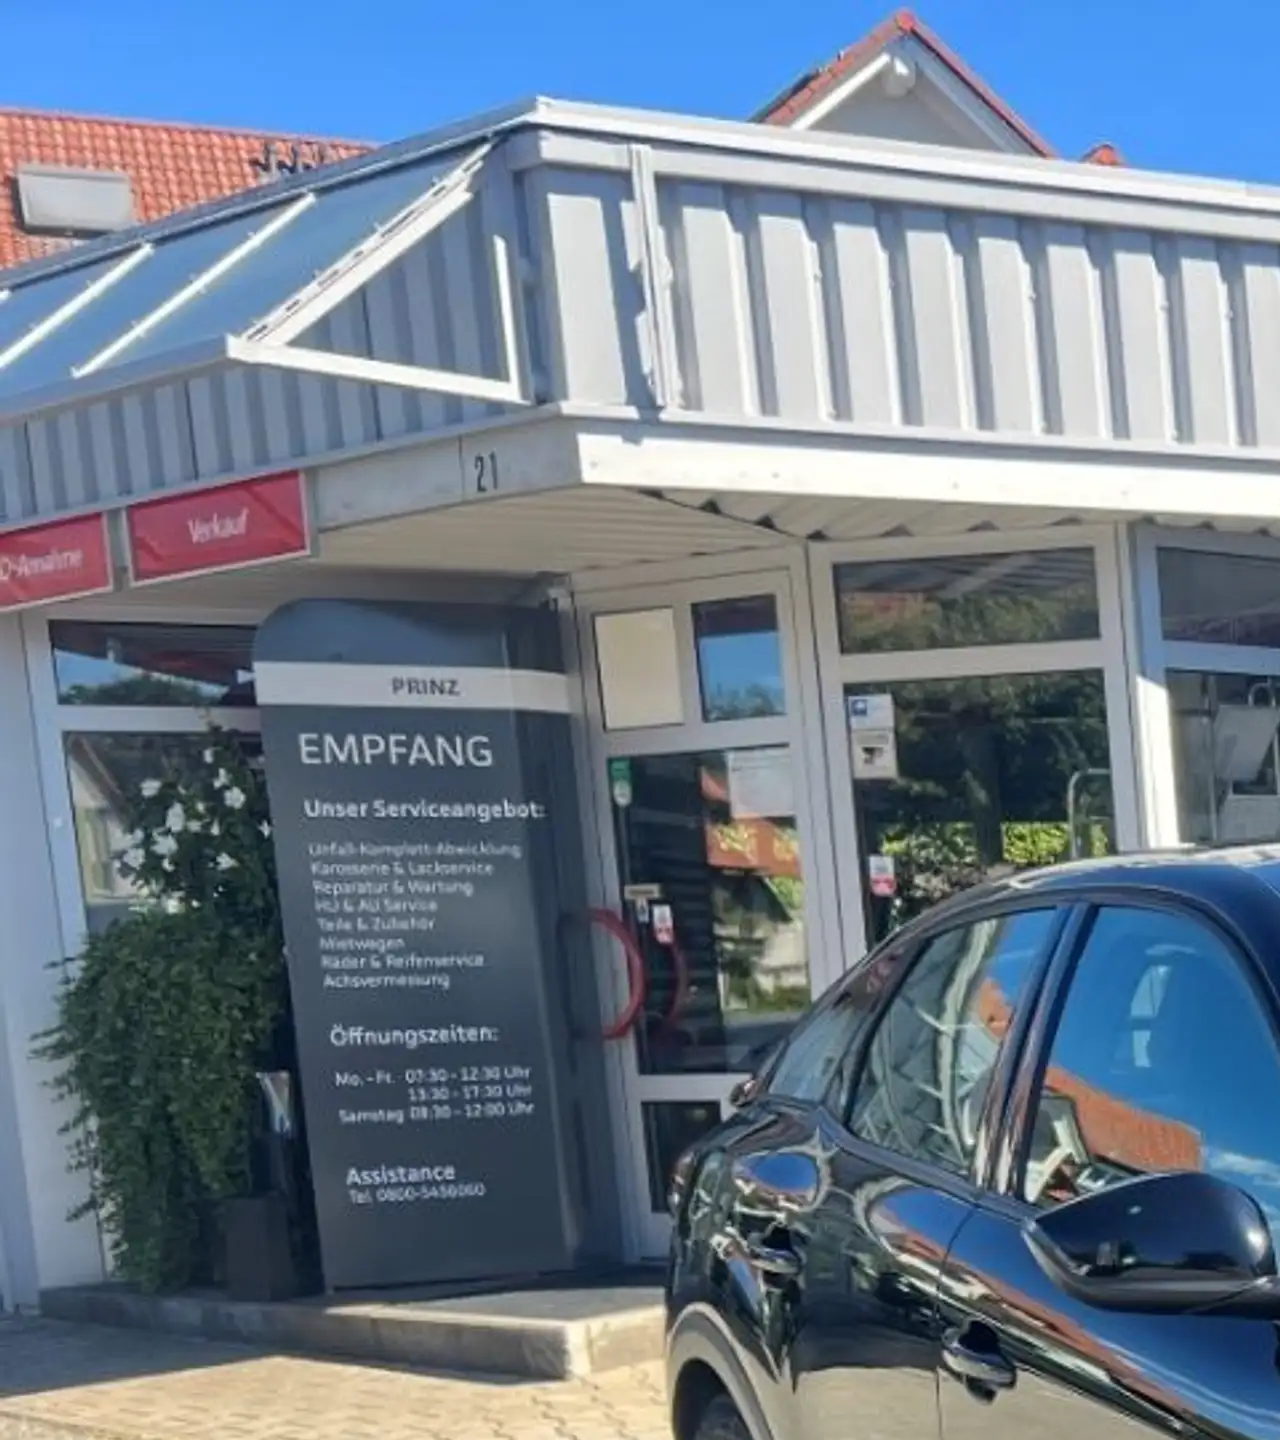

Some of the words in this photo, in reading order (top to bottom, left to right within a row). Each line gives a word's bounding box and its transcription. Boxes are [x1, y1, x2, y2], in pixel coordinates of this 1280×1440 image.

[475, 453, 498, 492] 21
[187, 507, 249, 543] Verkauf
[391, 676, 460, 696] PRINZ
[298, 733, 493, 768] EMPFANG
[304, 801, 367, 818] Unser
[373, 799, 546, 823] Serviceangebot:
[312, 880, 388, 896] Reparatur
[408, 880, 474, 897] Wartung
[384, 899, 438, 913] Service
[319, 936, 405, 953] Mietwagen
[323, 972, 450, 990] Achsvermessung
[330, 1023, 499, 1049] Öffnungszeiten:
[504, 1064, 531, 1079] Uhr
[506, 1083, 532, 1098] Uhr
[338, 1108, 404, 1125] Samstag
[507, 1101, 535, 1116] Uhr
[346, 1164, 456, 1186] Assistance
